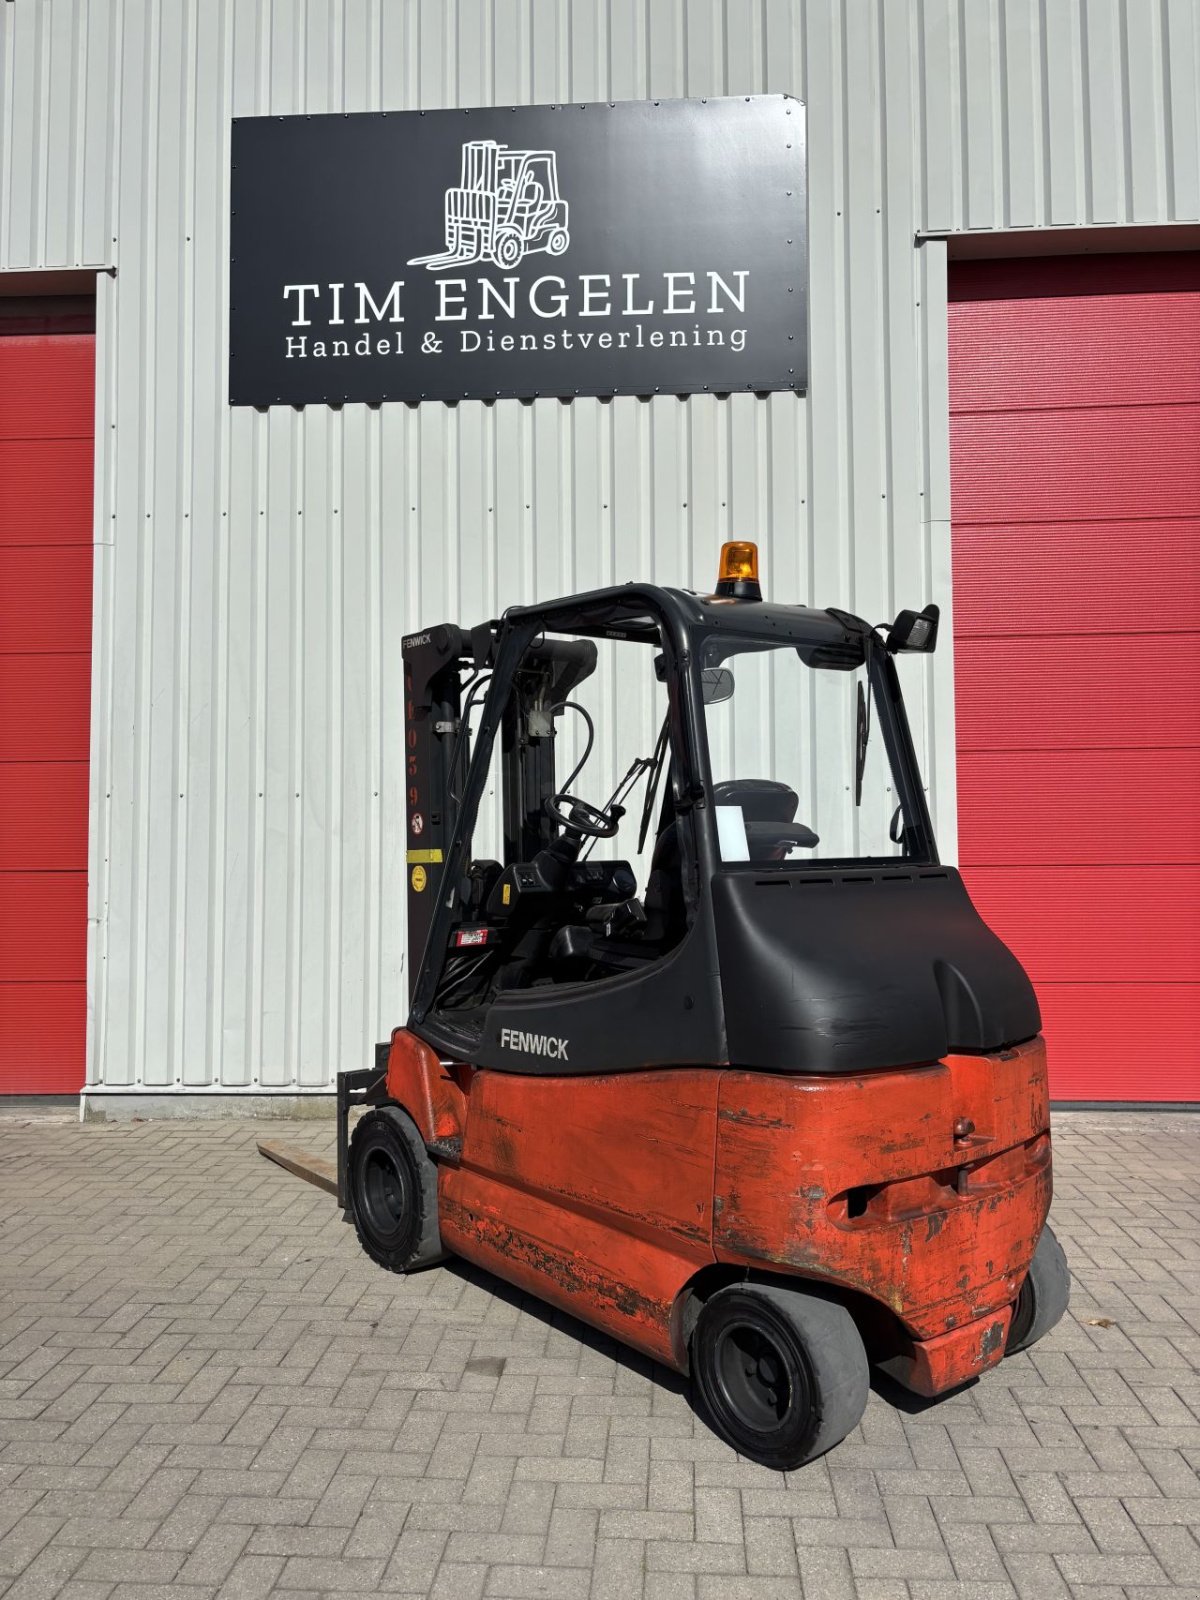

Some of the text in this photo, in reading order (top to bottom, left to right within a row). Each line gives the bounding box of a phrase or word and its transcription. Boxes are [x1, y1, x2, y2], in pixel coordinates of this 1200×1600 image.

[283, 270, 750, 326] TIM ENGELEN
[285, 323, 748, 358] Handel & Dienstverlening
[402, 633, 431, 649] FENWICK
[501, 1028, 569, 1061] FENWICK
